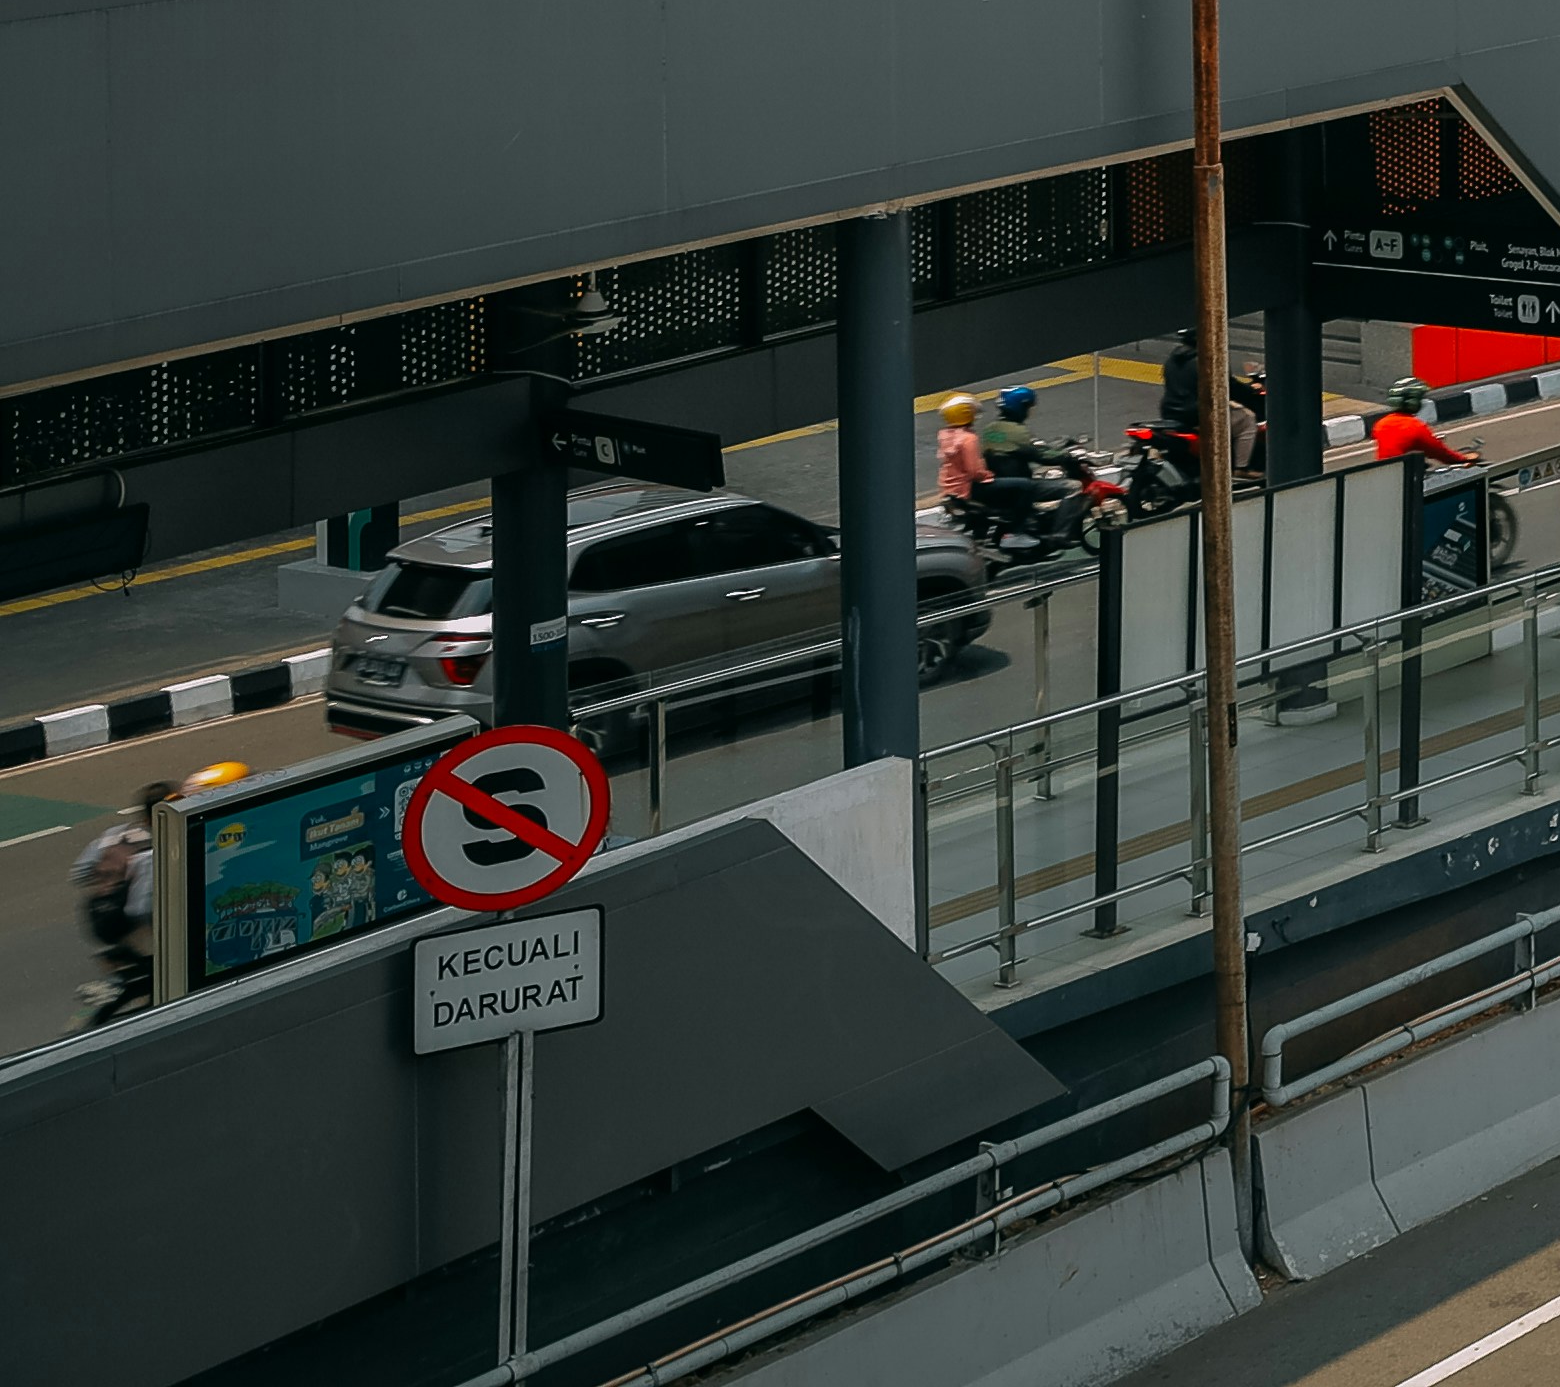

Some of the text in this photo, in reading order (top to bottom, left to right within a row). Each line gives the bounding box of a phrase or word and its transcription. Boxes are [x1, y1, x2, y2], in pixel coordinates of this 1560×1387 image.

[1489, 294, 1514, 307] Toilet
[461, 767, 549, 867] S
[437, 930, 583, 982] KECUALI
[432, 975, 584, 1028] DARURAT
